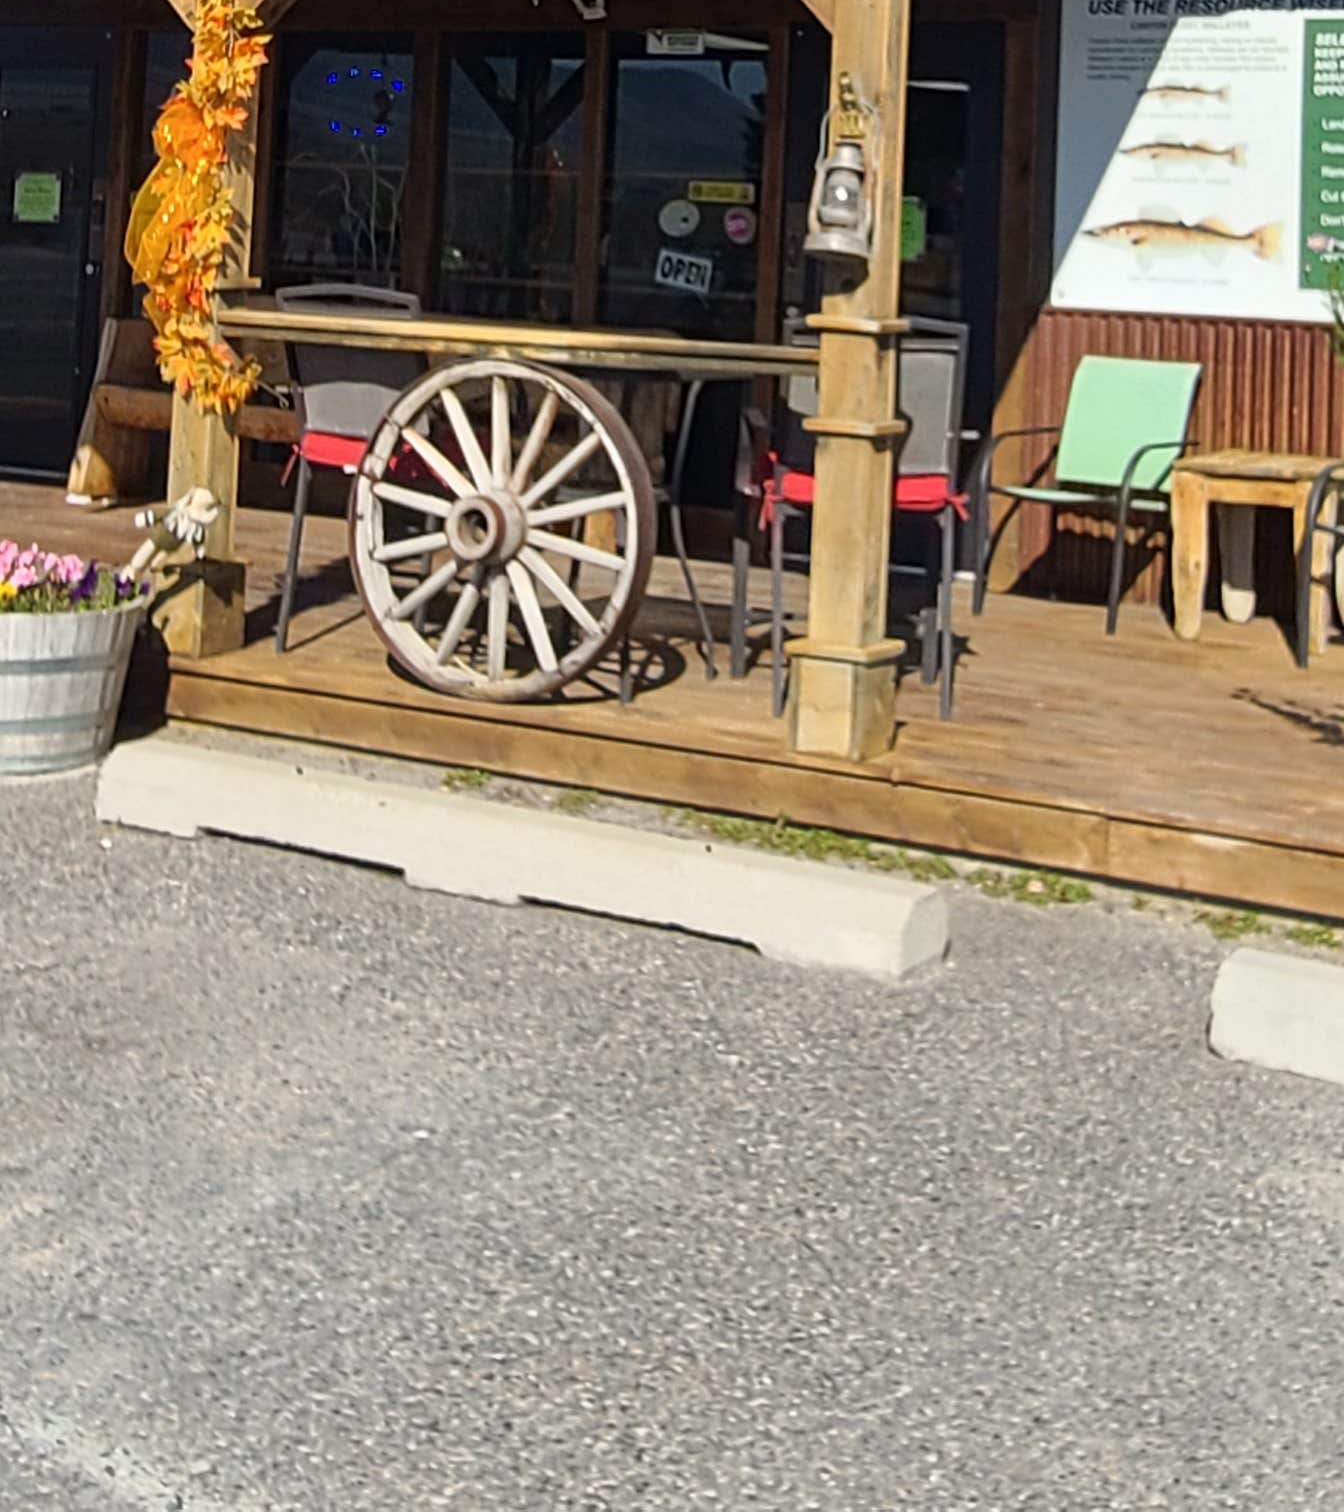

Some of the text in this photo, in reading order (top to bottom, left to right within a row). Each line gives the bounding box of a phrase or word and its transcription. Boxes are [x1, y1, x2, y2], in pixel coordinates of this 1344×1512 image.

[1314, 59, 1338, 71] AND
[1320, 190, 1339, 203] Cut
[660, 254, 709, 288] OPEN
